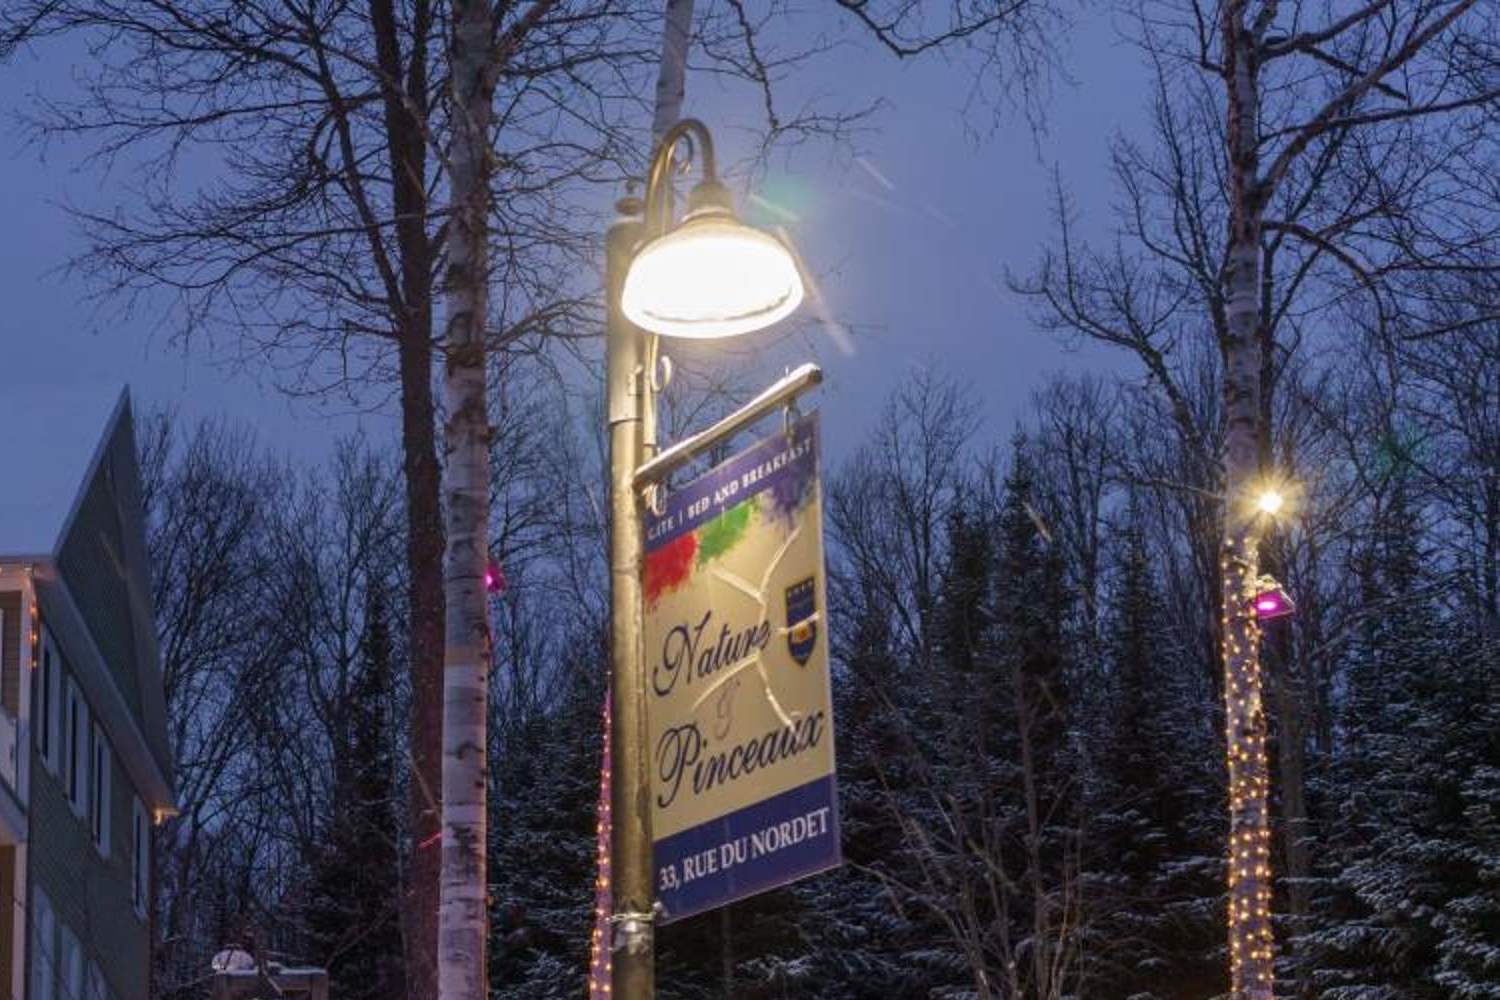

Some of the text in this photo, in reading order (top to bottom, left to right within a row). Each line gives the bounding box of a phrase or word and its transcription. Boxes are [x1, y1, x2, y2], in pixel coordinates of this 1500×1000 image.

[687, 497, 709, 519] BED
[713, 480, 739, 504] AND
[741, 437, 812, 489] BREAKFAST
[653, 609, 771, 697] Nature
[655, 710, 824, 809] Pinceaux
[659, 807, 830, 891] 33, RUE DU NORDET
